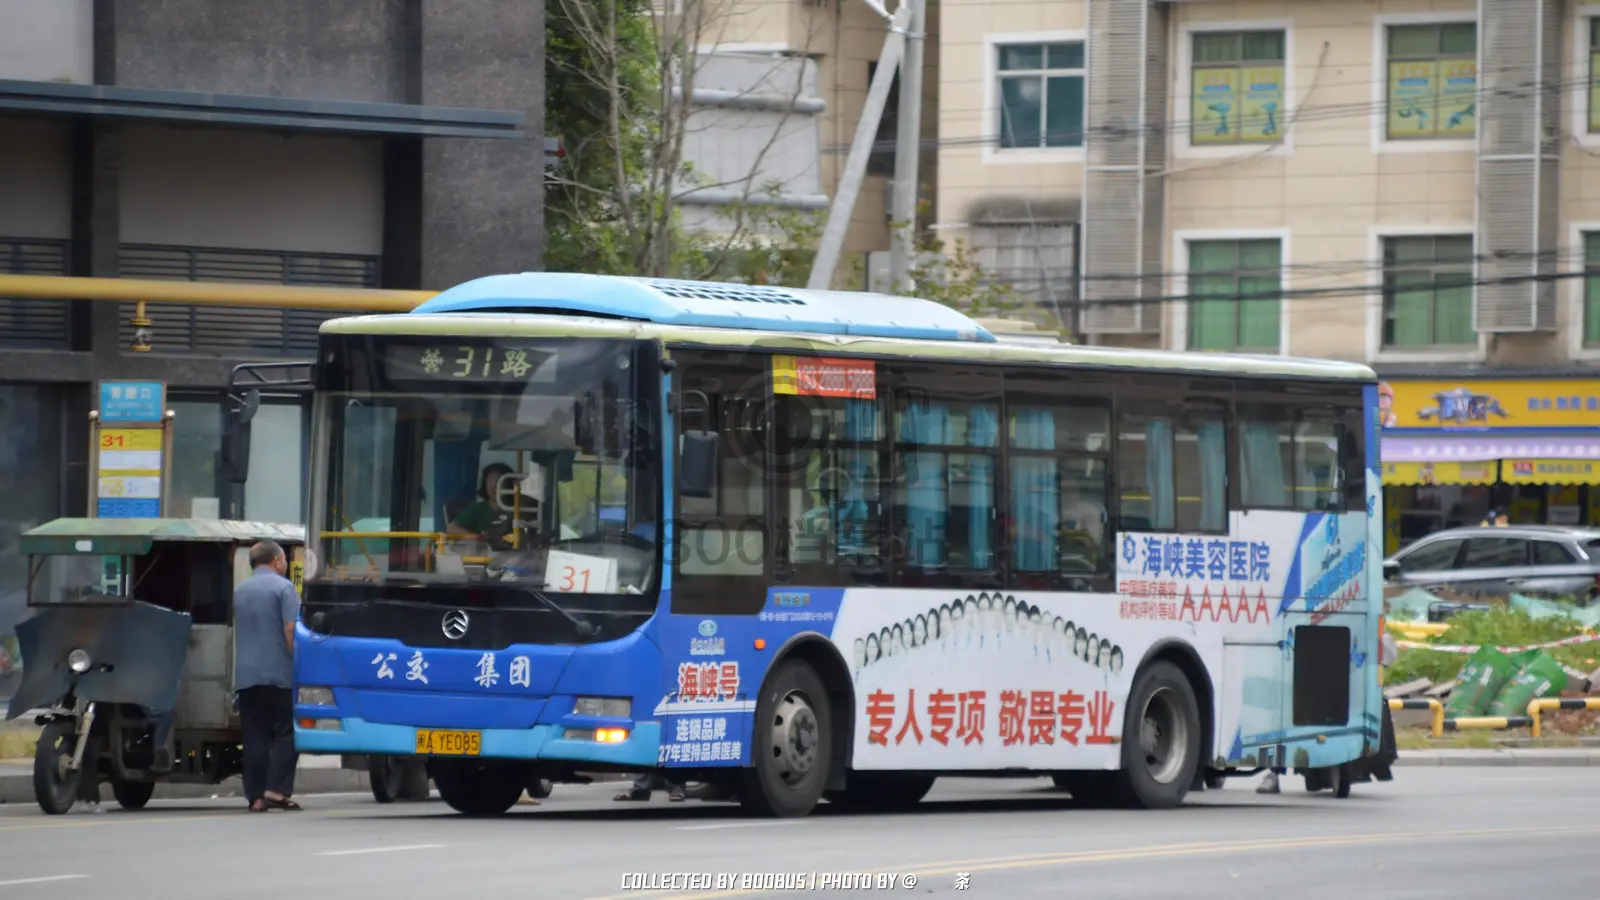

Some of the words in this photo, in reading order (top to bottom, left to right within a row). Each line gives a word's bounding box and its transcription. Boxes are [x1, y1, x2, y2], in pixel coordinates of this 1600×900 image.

[453, 346, 532, 378] 31路
[102, 434, 124, 447] 31
[1142, 536, 1270, 582] 海峡美容医院
[559, 565, 591, 596] 31
[1178, 583, 1271, 625] AAAAA
[371, 651, 429, 684] 公交
[474, 652, 531, 688] 集团
[678, 661, 739, 701] 海峡号
[676, 718, 727, 742] 连锁品牌
[866, 688, 986, 747] 专人专项
[998, 689, 1115, 747] 敬畏专业
[658, 741, 742, 763] 27年坚持品质医美
